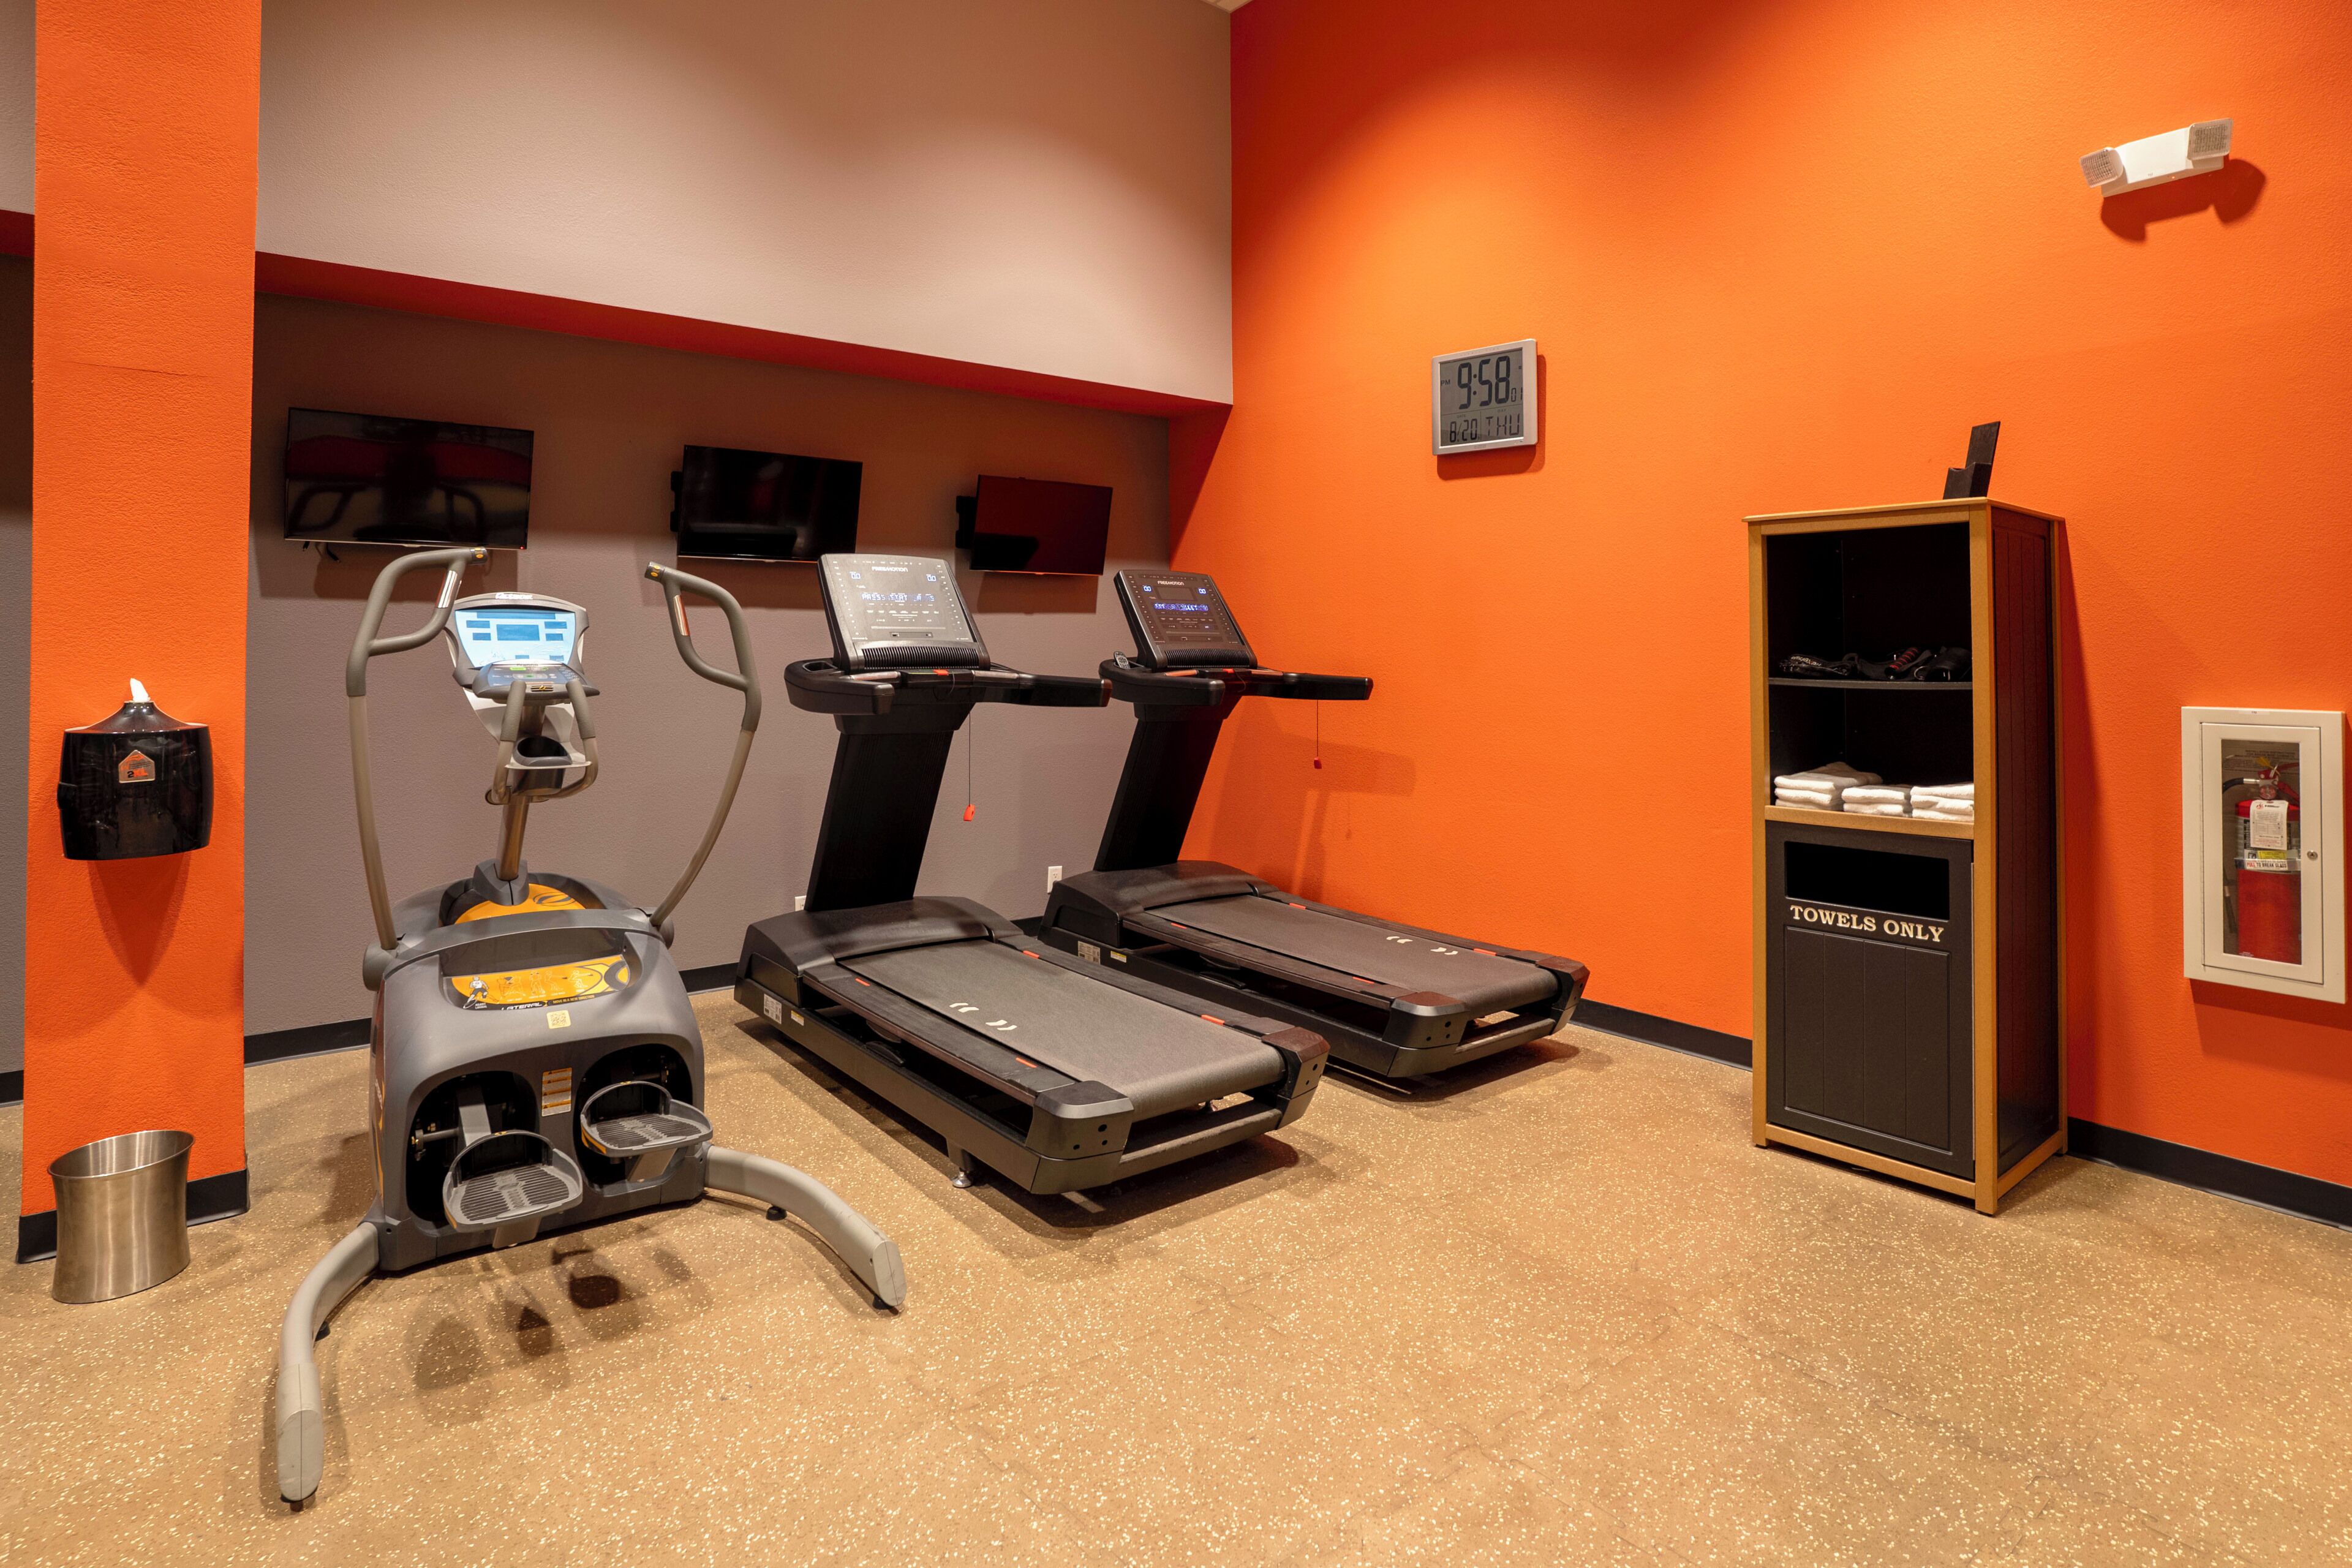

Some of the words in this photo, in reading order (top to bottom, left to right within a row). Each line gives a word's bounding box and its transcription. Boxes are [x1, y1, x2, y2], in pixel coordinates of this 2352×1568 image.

[1458, 355, 1510, 410] 9:58
[1485, 413, 1520, 436] THU
[1790, 905, 1877, 932] TOWELS
[1883, 919, 1944, 942] ONLY
[502, 1002, 543, 1011] ATERAL
